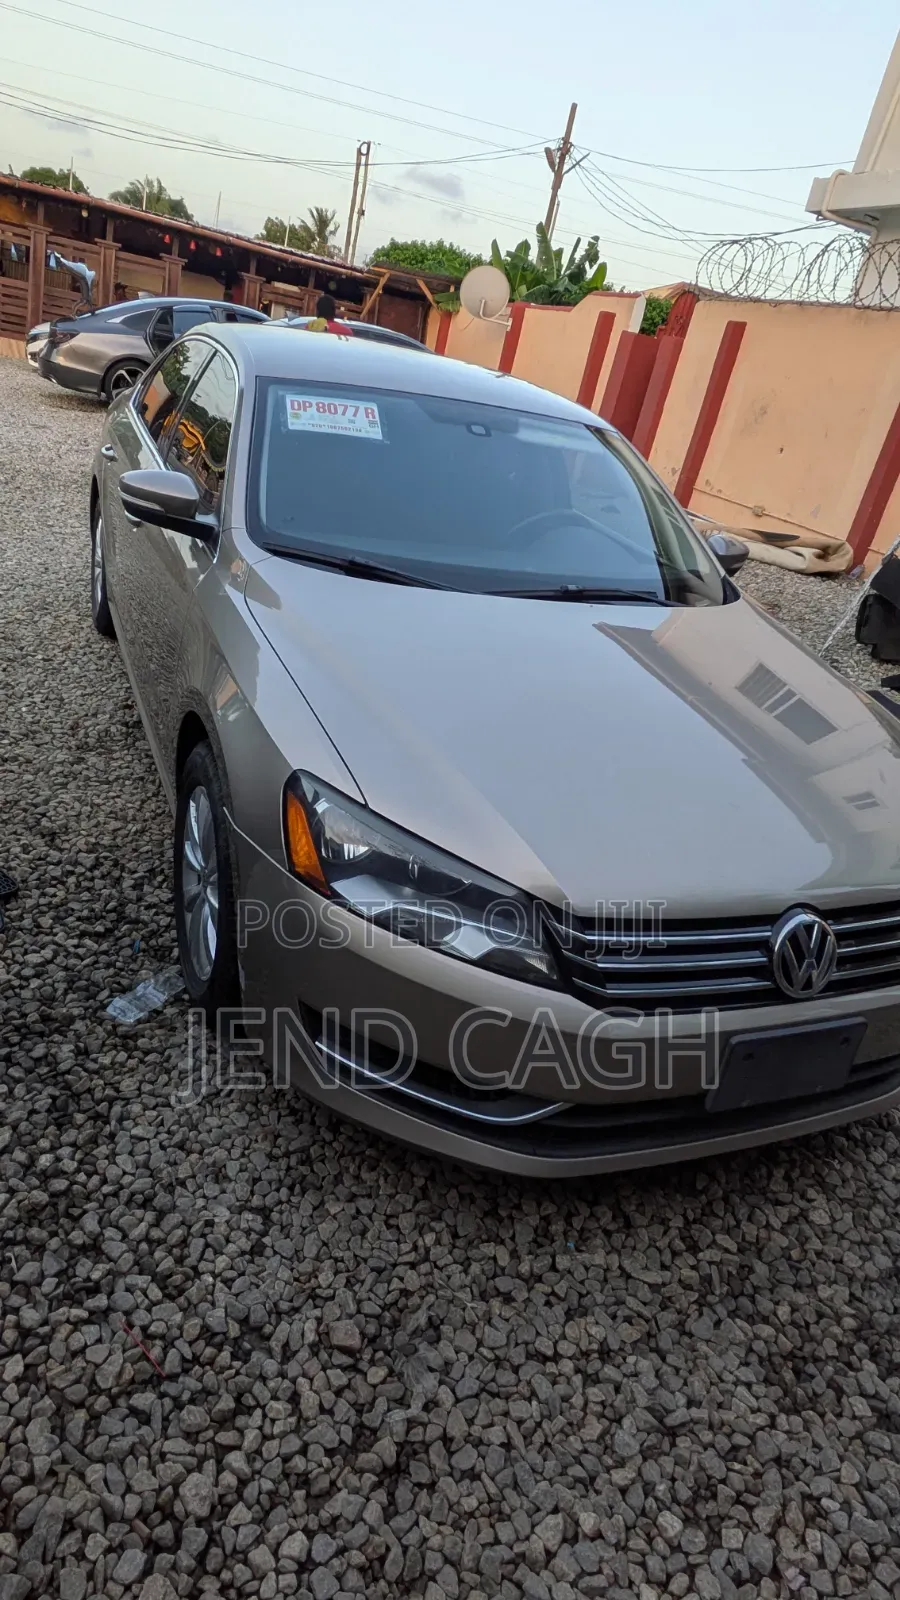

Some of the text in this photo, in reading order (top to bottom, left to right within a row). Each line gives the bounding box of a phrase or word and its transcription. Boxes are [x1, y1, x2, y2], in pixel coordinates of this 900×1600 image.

[289, 399, 376, 420] DP 8077 R
